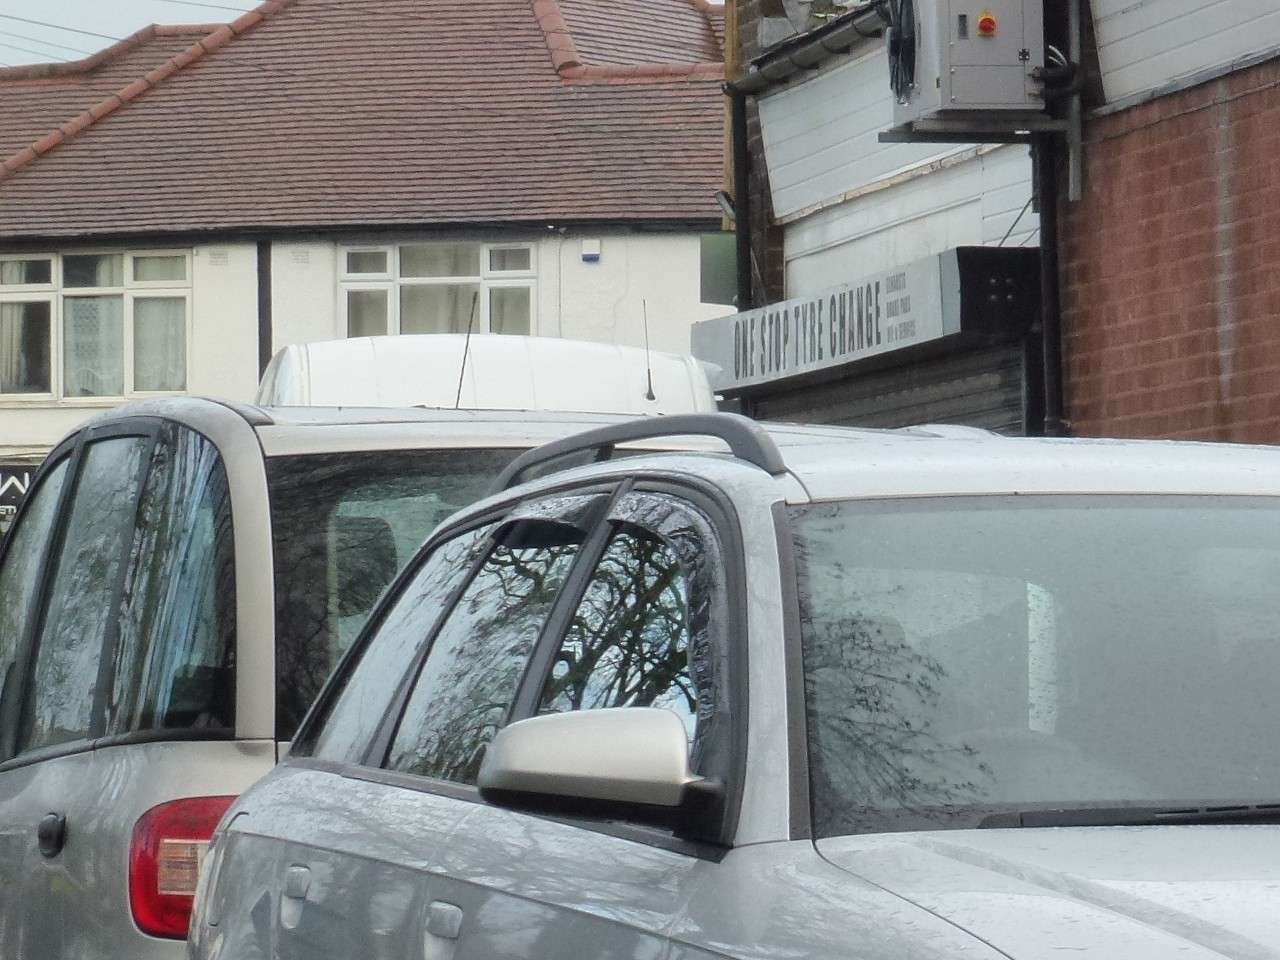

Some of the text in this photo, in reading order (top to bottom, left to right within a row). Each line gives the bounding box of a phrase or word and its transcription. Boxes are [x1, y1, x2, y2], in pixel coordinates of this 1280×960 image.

[735, 281, 881, 380] ONE STOP TYRE CHANGE
